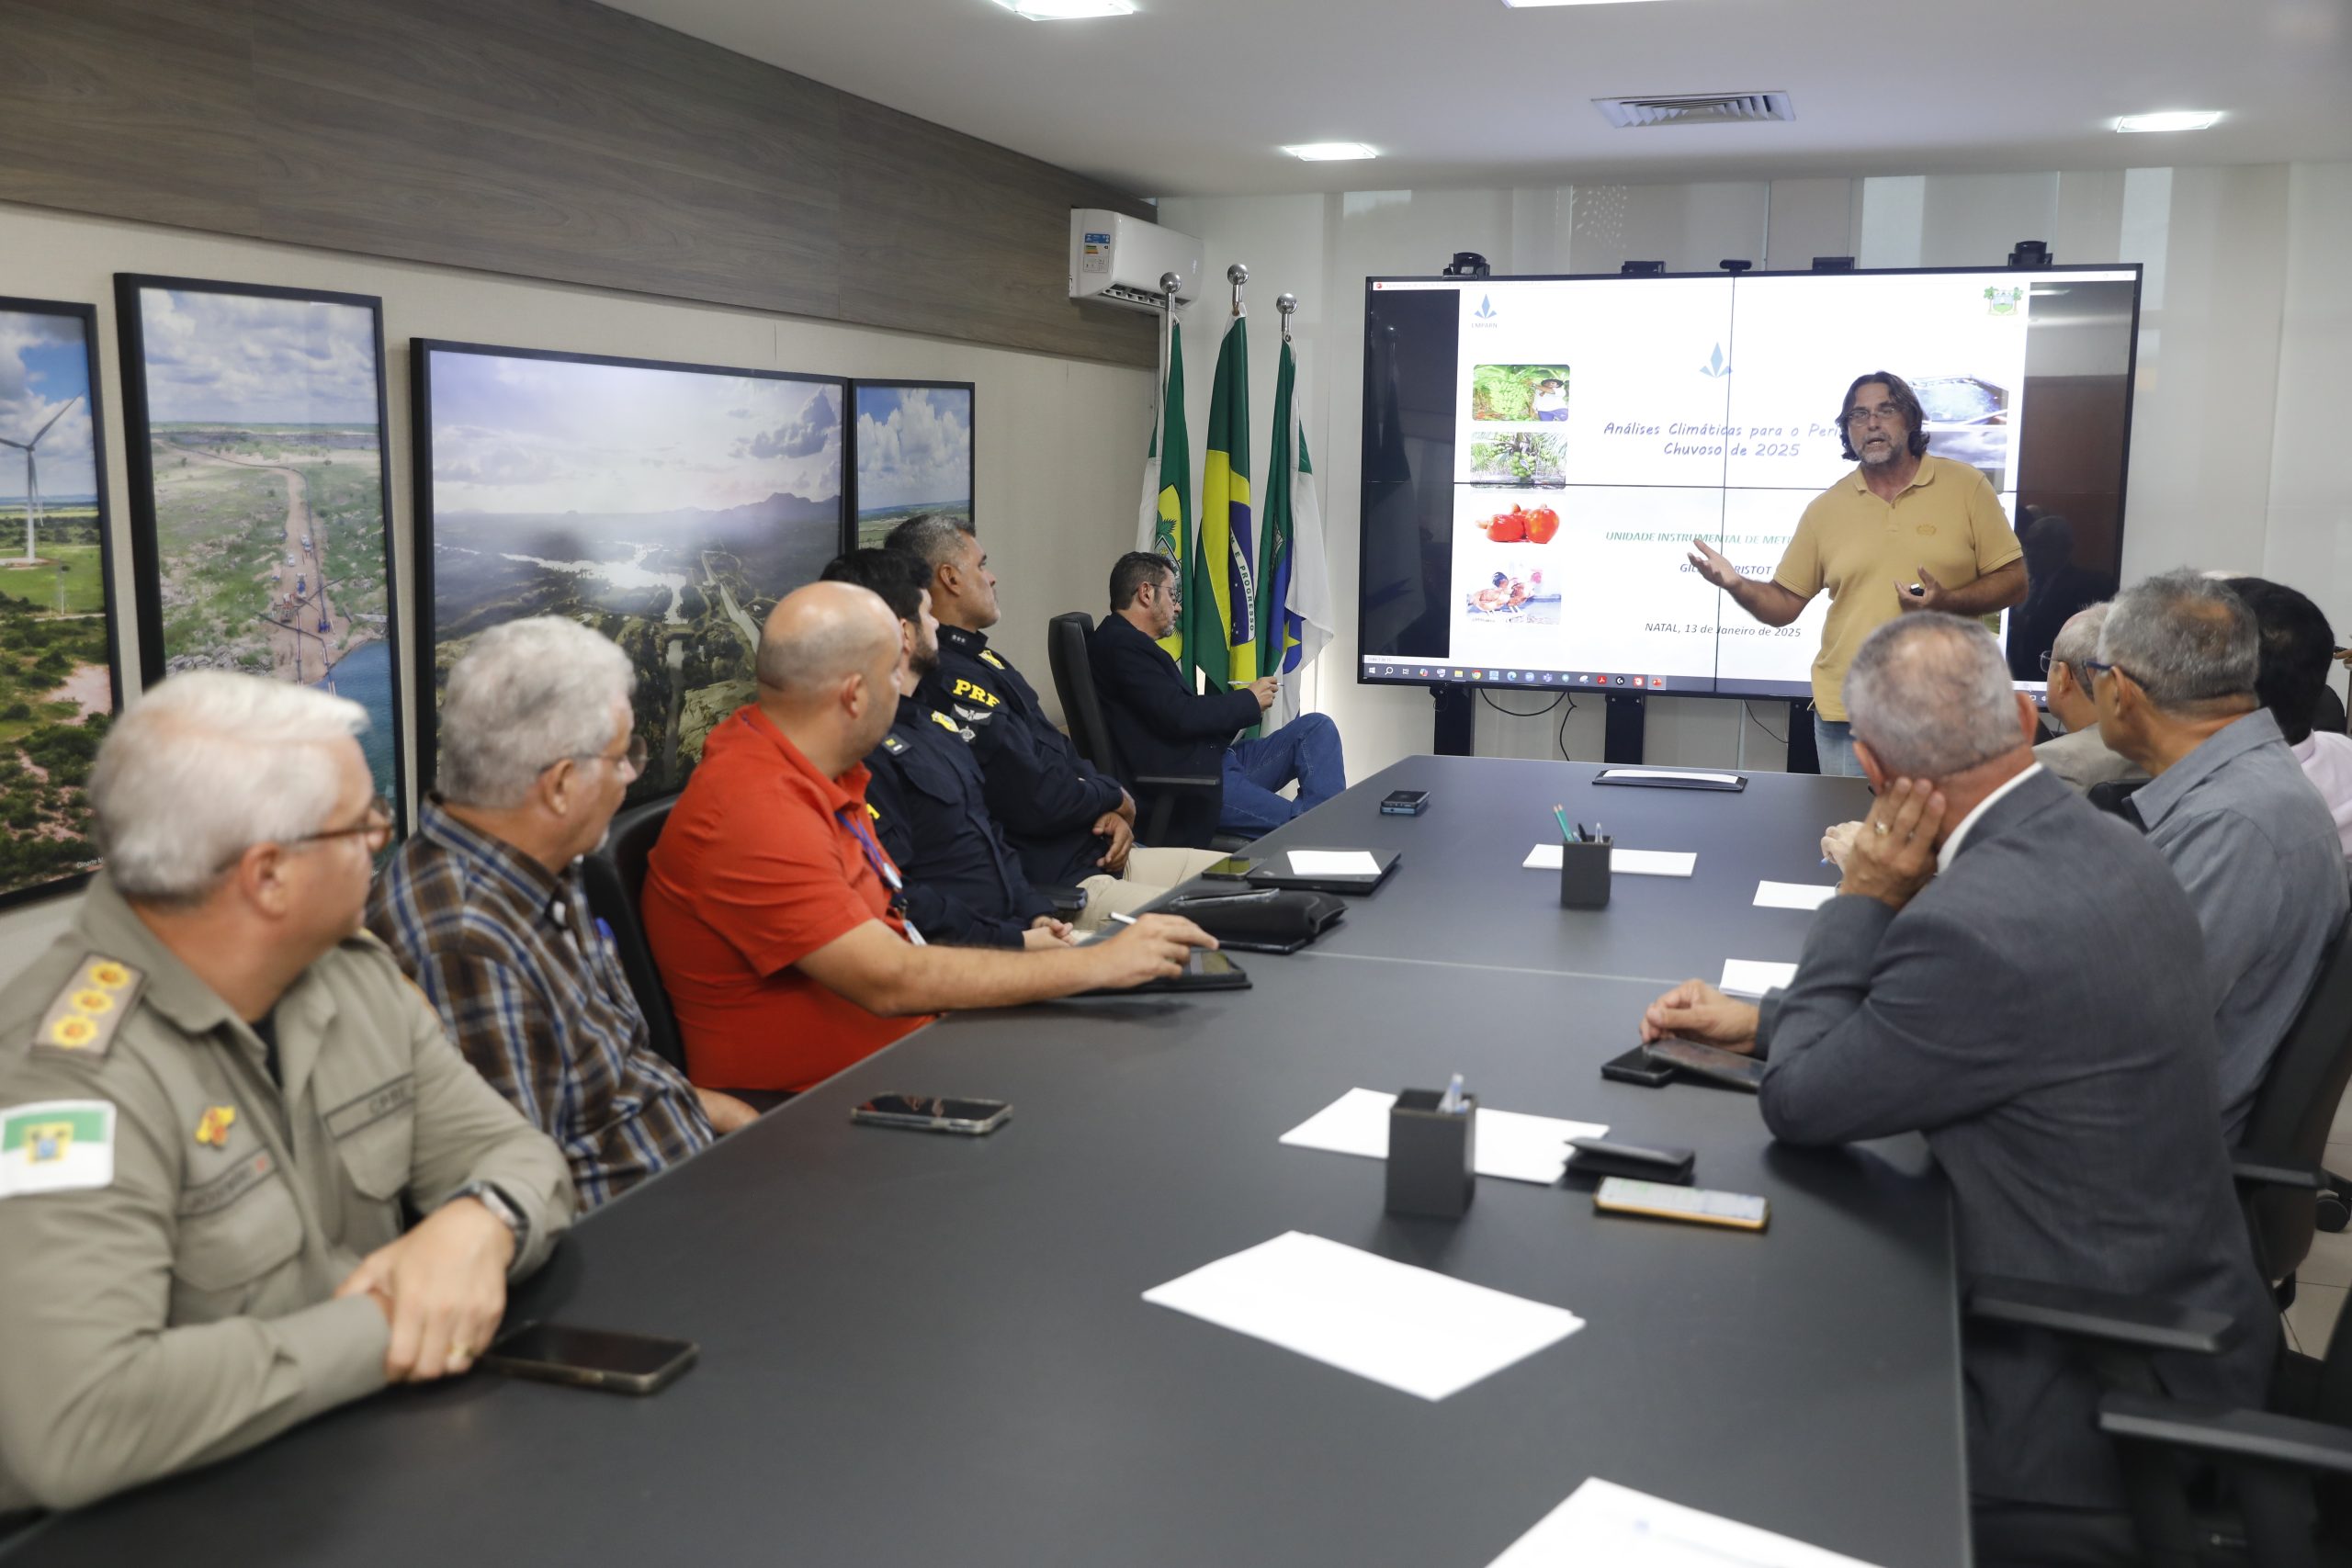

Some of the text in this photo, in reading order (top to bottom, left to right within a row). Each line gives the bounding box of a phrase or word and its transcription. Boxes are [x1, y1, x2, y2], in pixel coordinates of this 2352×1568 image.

[1603, 422, 1660, 435] Análises
[1668, 422, 1742, 436] Climáticas
[1749, 426, 1782, 439] para
[1790, 427, 1800, 437] o
[1664, 442, 1801, 457] Chuvoso de 2025
[1606, 531, 1656, 542] UNIDADE
[1657, 531, 1742, 545] INSTRUMENTAL
[1745, 535, 1760, 545] DE
[1680, 563, 1772, 575] GIL RISTOT
[1238, 564, 1254, 632] PROGRESSO
[1645, 623, 1802, 637] NATAL, 13 de Janeiro de 2025
[953, 679, 1001, 708] PRF
